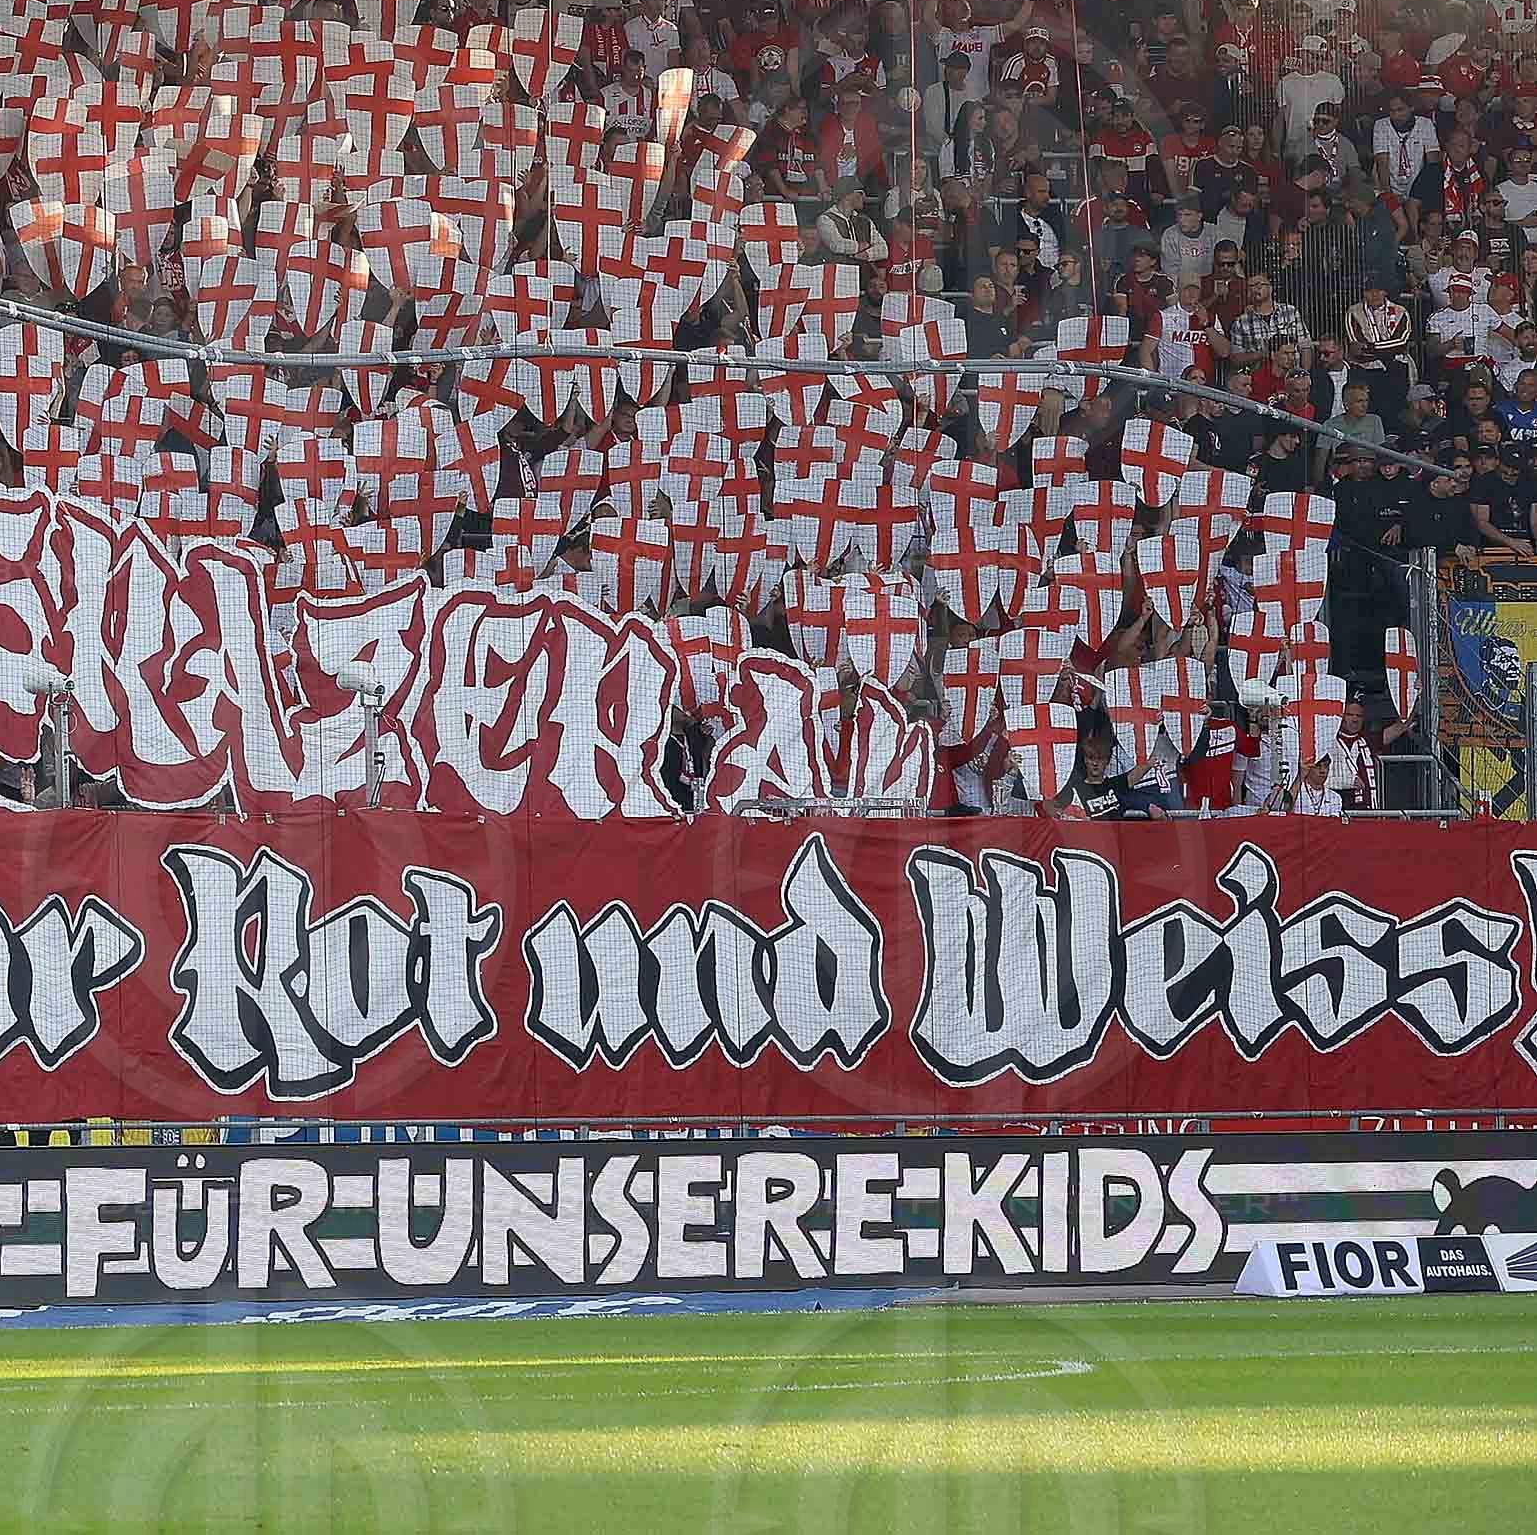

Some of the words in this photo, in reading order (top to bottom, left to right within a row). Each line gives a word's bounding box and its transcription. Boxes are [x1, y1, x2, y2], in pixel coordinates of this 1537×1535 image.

[161, 842, 502, 1100] Rot
[523, 831, 892, 1072] und
[906, 842, 1521, 1088] Weiss
[1277, 1241, 1420, 1291] FIOR
[1425, 1264, 1493, 1279] AUTOHAUS.
[1439, 1248, 1465, 1263] DAS
